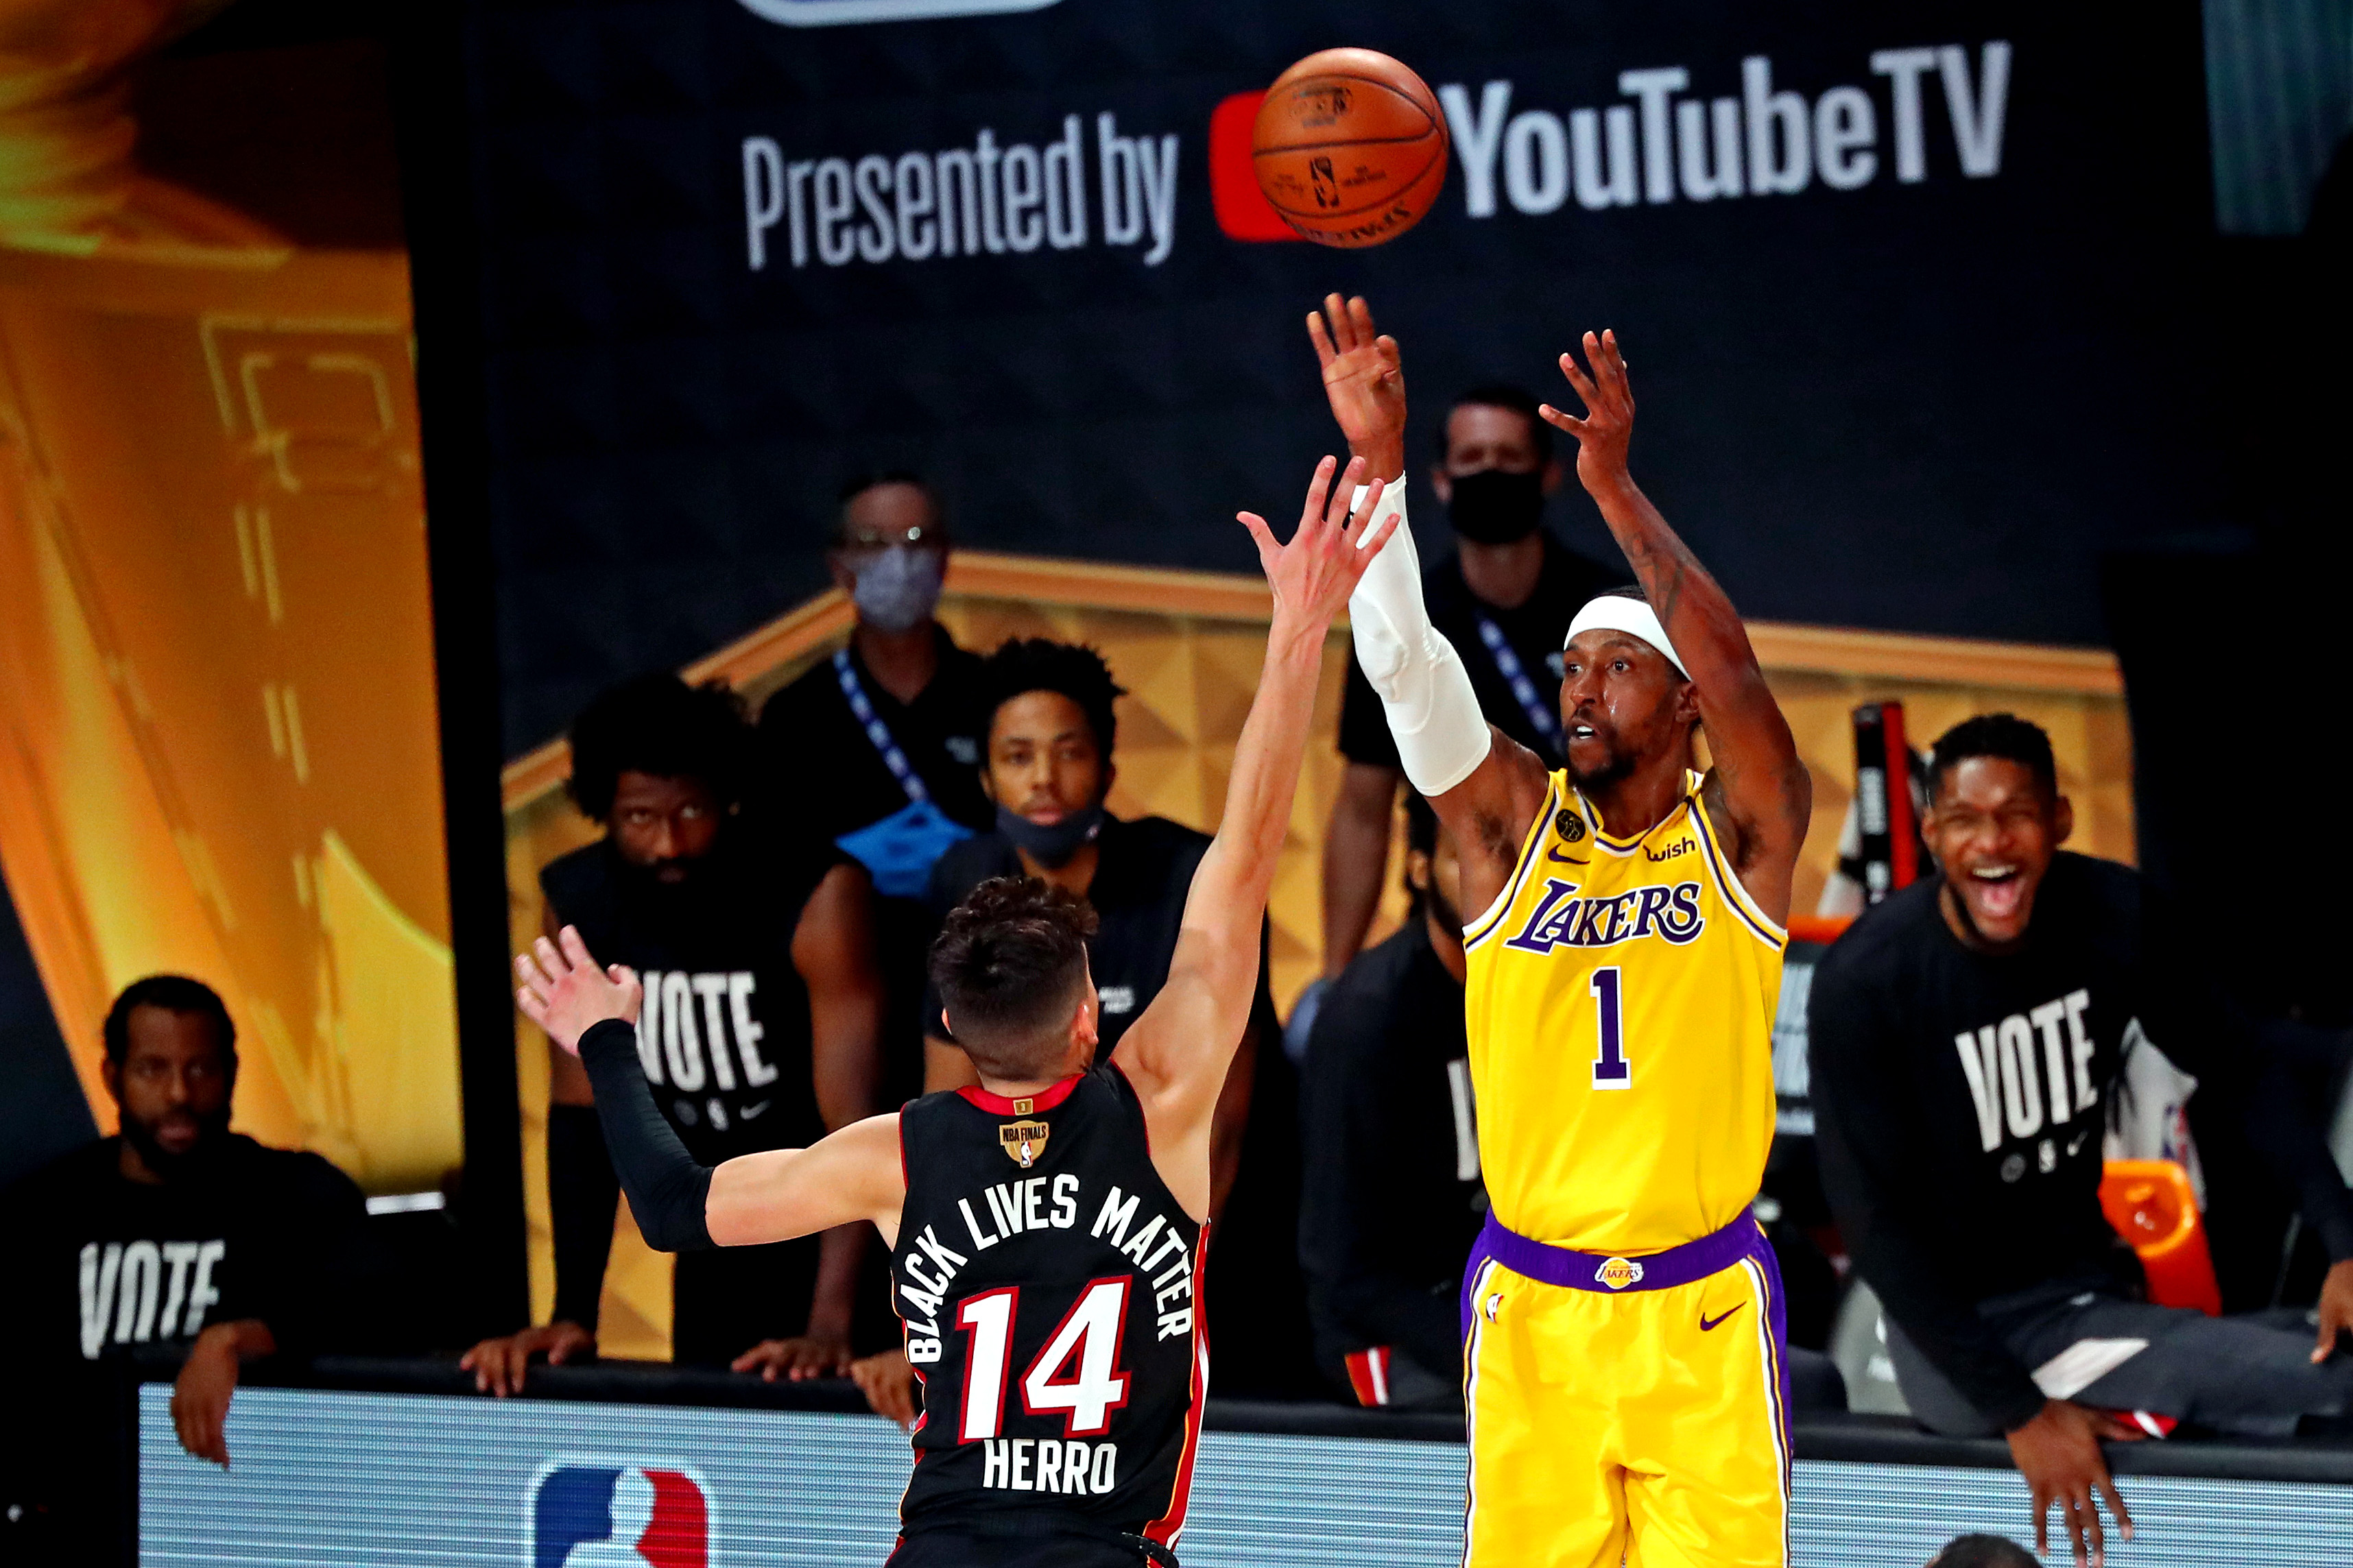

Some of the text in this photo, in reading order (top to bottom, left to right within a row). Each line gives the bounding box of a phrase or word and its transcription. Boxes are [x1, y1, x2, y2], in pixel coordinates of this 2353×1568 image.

[742, 112, 1088, 269] Presented
[1098, 110, 1179, 266] by
[1643, 836, 1696, 863] wish
[1502, 876, 1706, 956] LAKERS
[634, 969, 779, 1091] VOTE
[1590, 966, 1632, 1090] 1
[1954, 987, 2099, 1153] VOTE
[1003, 1125, 1047, 1142] NBA FINALS
[79, 1239, 226, 1360] VOTE
[900, 1173, 1193, 1364] BLACK LIVES MATTER
[955, 1275, 1133, 1445] 14
[983, 1439, 1118, 1495] HERRO
